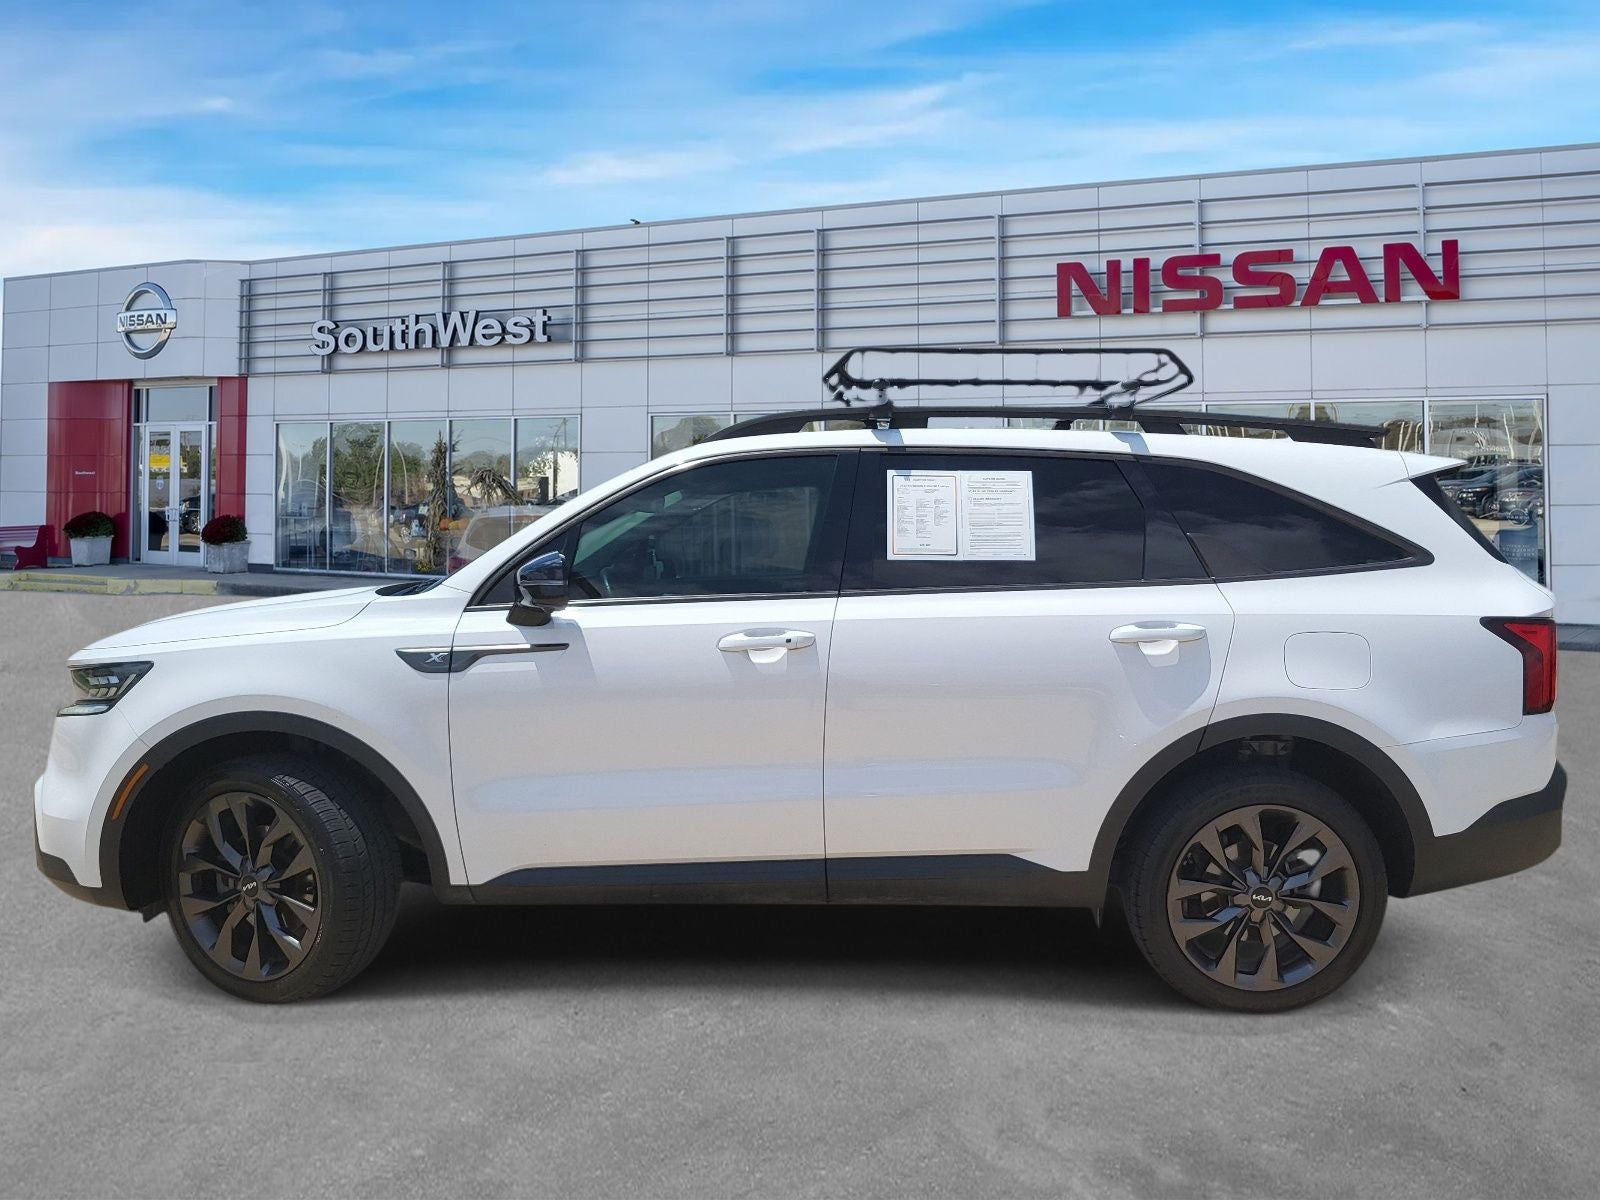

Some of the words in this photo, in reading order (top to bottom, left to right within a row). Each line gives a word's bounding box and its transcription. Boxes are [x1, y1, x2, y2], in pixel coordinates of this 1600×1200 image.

[1056, 239, 1460, 318] NISSAN
[119, 313, 167, 328] NISSAN
[310, 309, 551, 356] SouthWest
